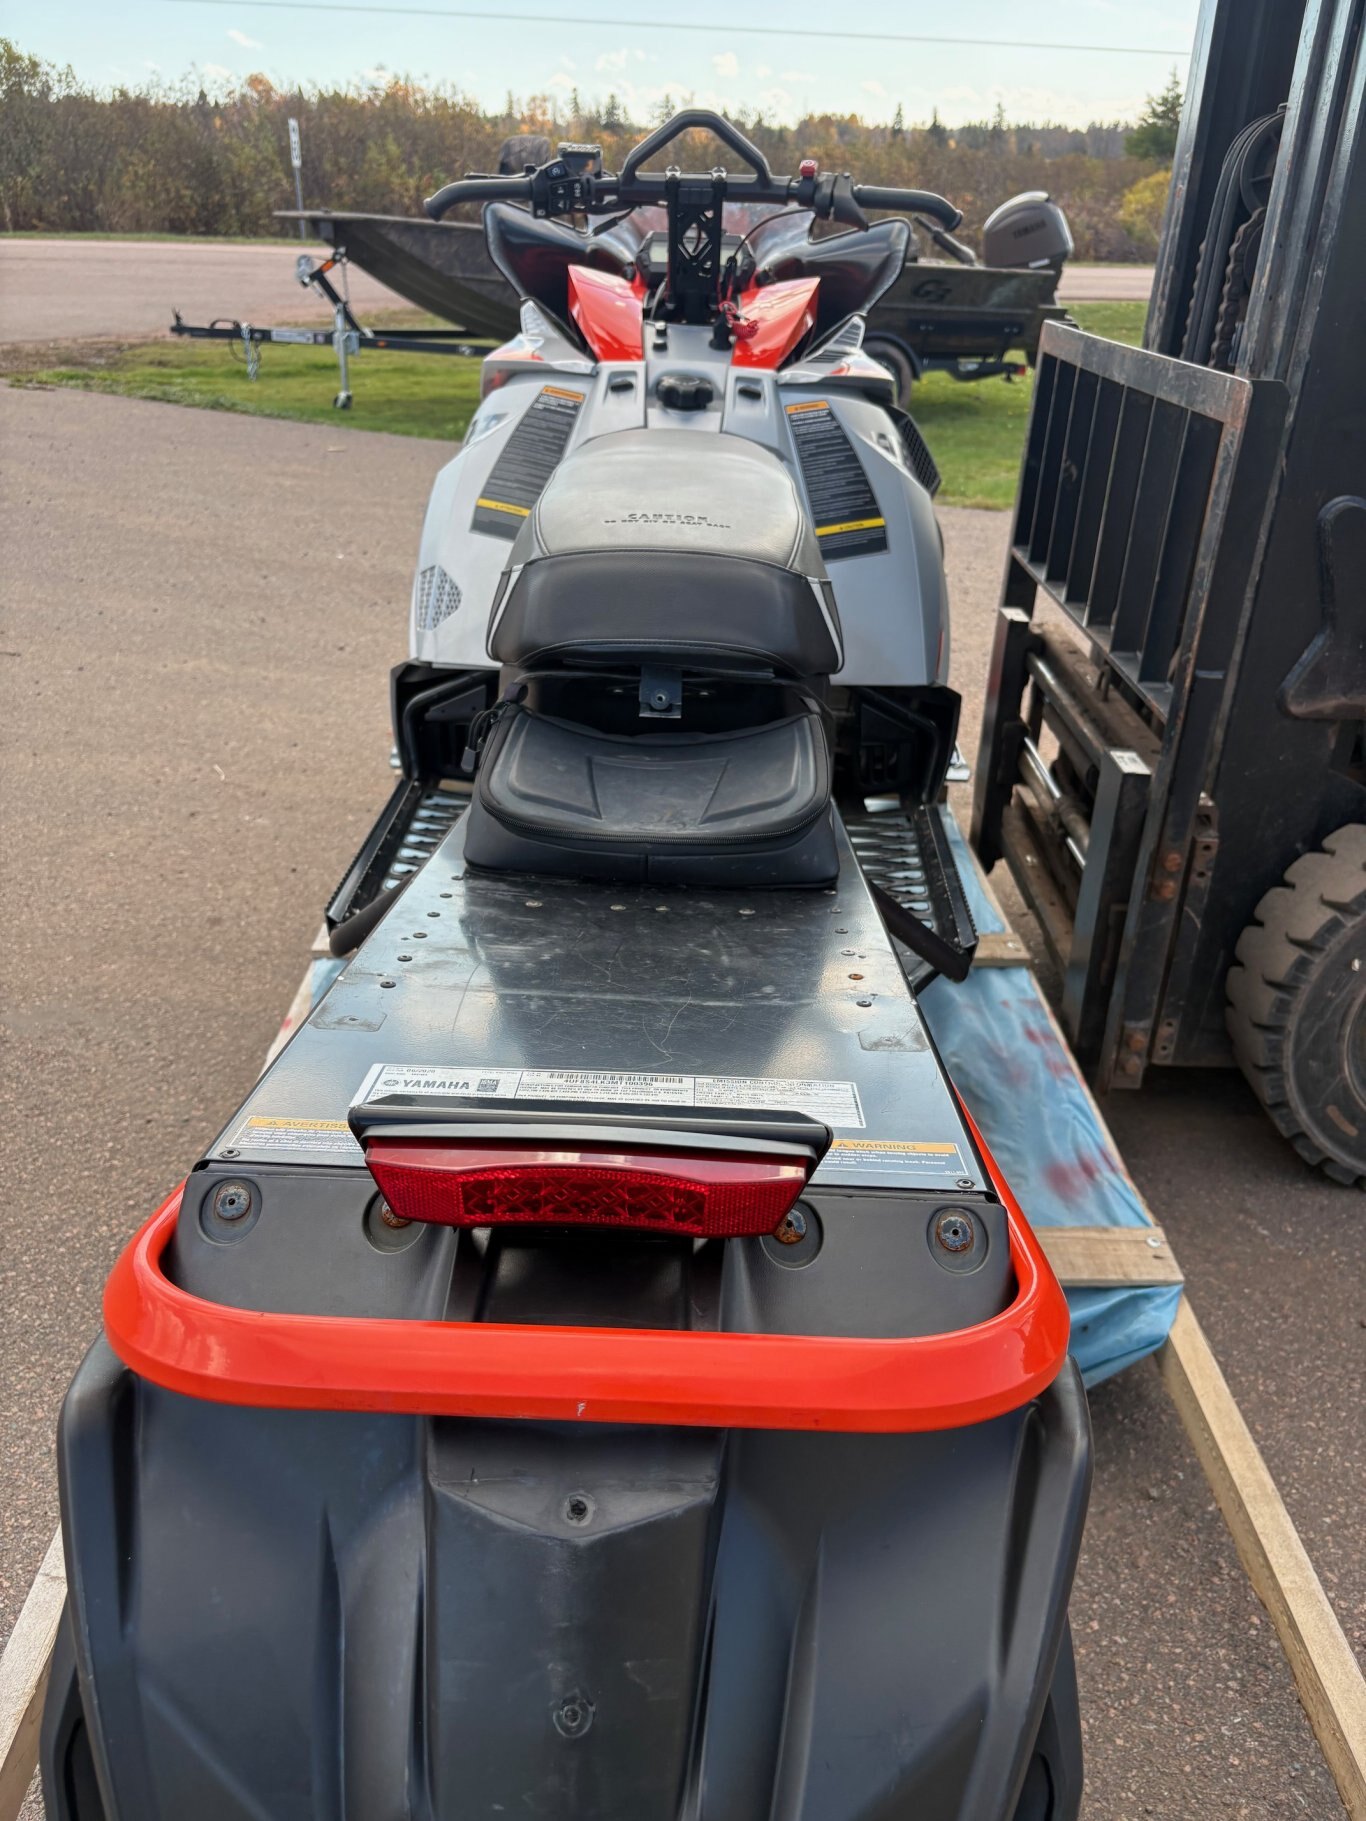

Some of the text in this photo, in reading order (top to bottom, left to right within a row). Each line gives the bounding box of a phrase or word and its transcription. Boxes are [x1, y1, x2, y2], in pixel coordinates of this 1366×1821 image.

[628, 513, 708, 522] CAUTION
[402, 1079, 470, 1090] YAMAHA
[283, 1121, 348, 1129] AVERTISS
